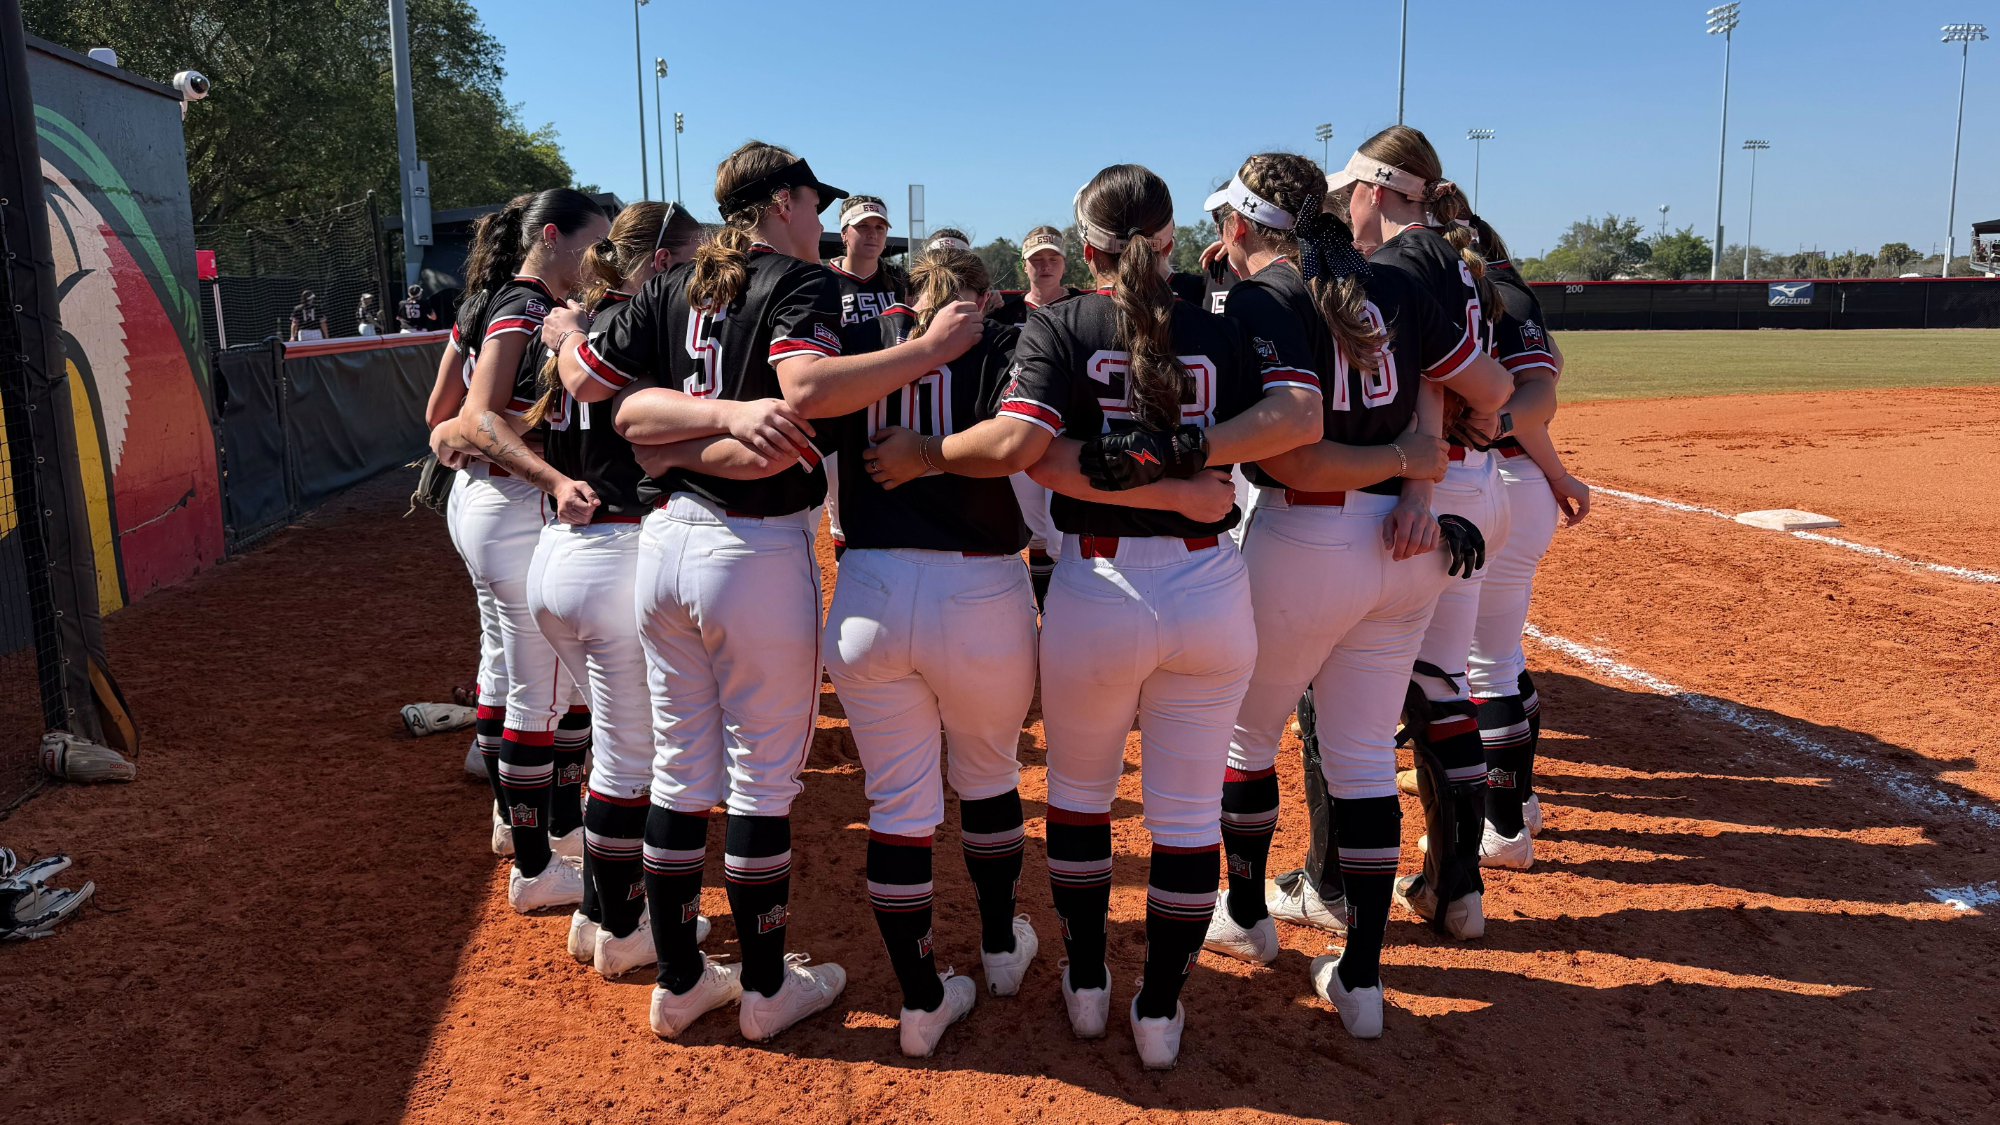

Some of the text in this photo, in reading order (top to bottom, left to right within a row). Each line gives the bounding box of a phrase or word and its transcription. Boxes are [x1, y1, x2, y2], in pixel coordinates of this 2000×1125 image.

[1037, 235, 1054, 244] ESU
[1565, 284, 1584, 294] 200
[683, 297, 723, 400] 5
